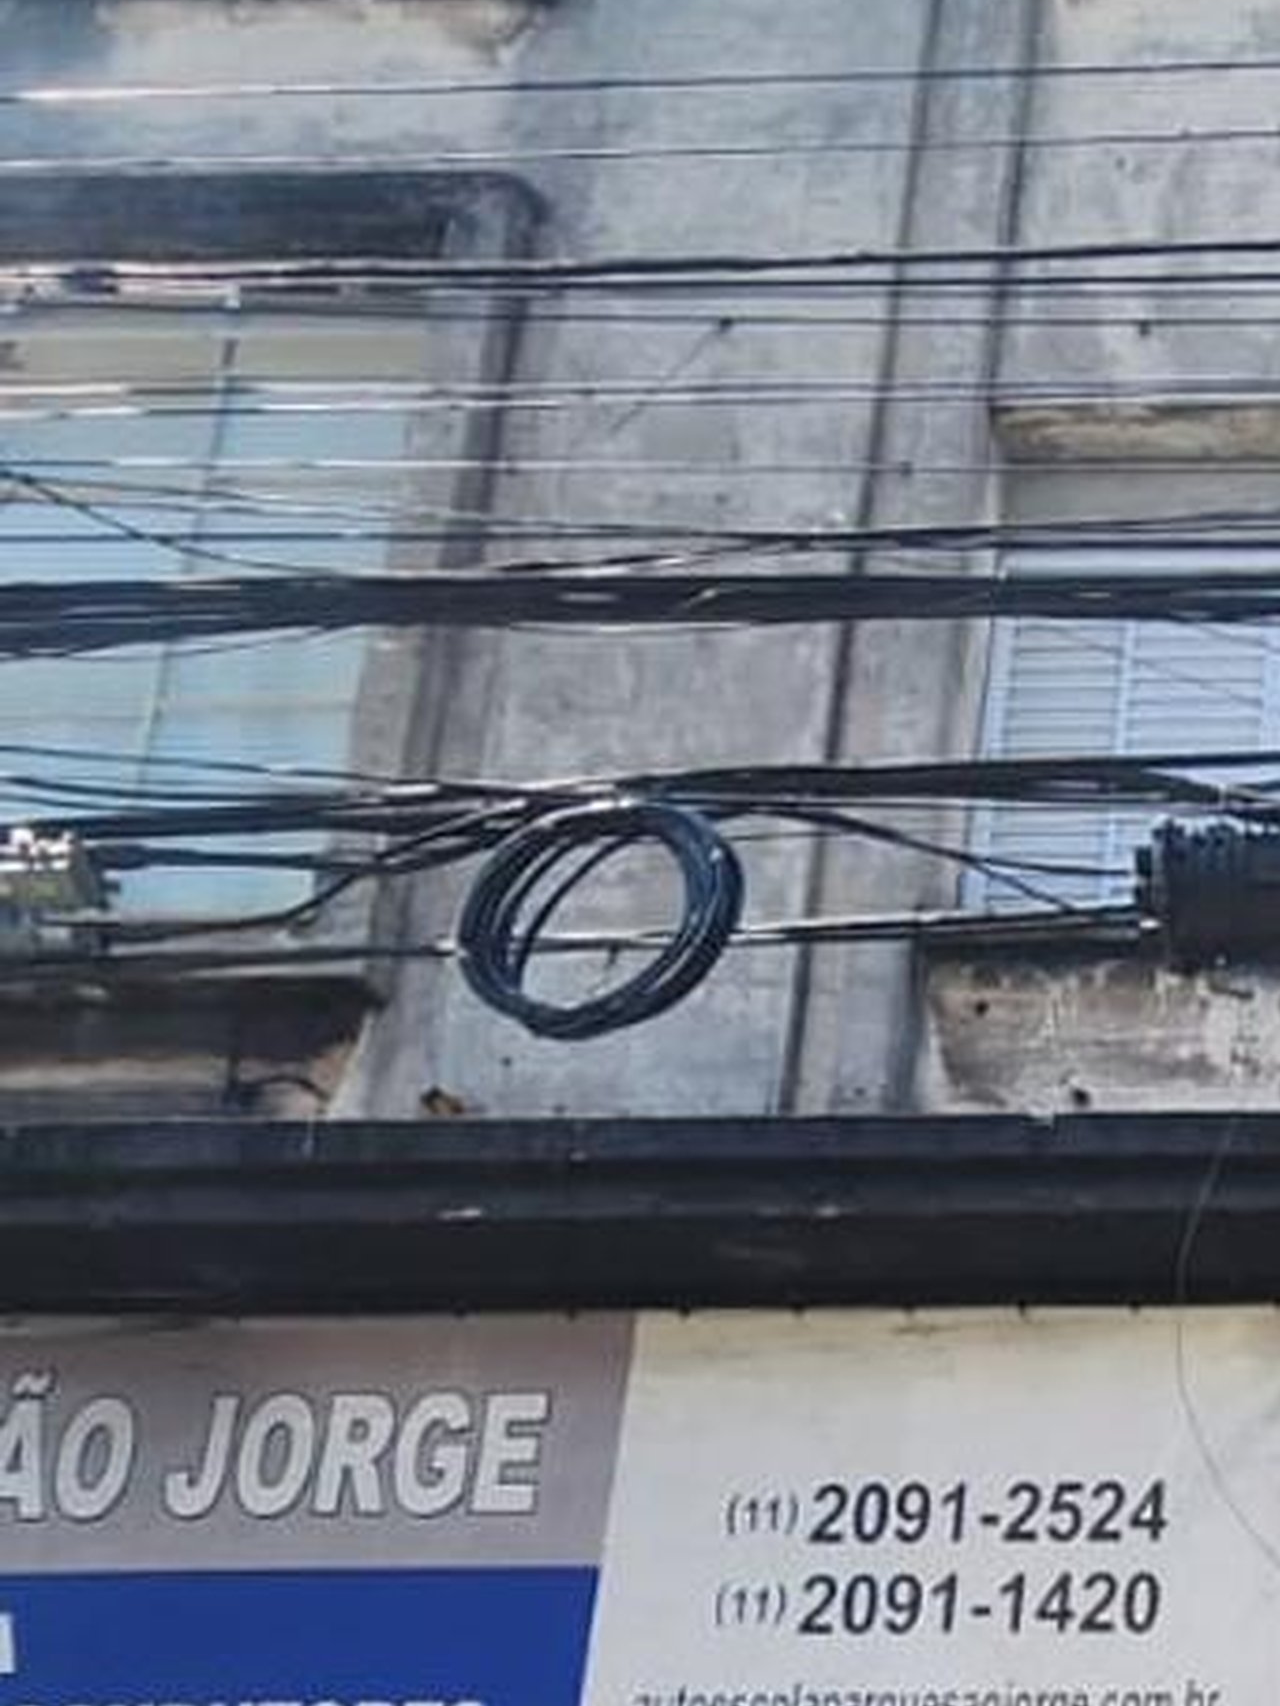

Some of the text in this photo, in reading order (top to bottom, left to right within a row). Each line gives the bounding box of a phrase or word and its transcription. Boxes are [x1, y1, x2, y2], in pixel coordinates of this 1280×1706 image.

[165, 1391, 549, 1518] JORGE
[725, 1481, 1168, 1543] (11) 2091-2524
[713, 1572, 1162, 1635] (11) 2091-1420
